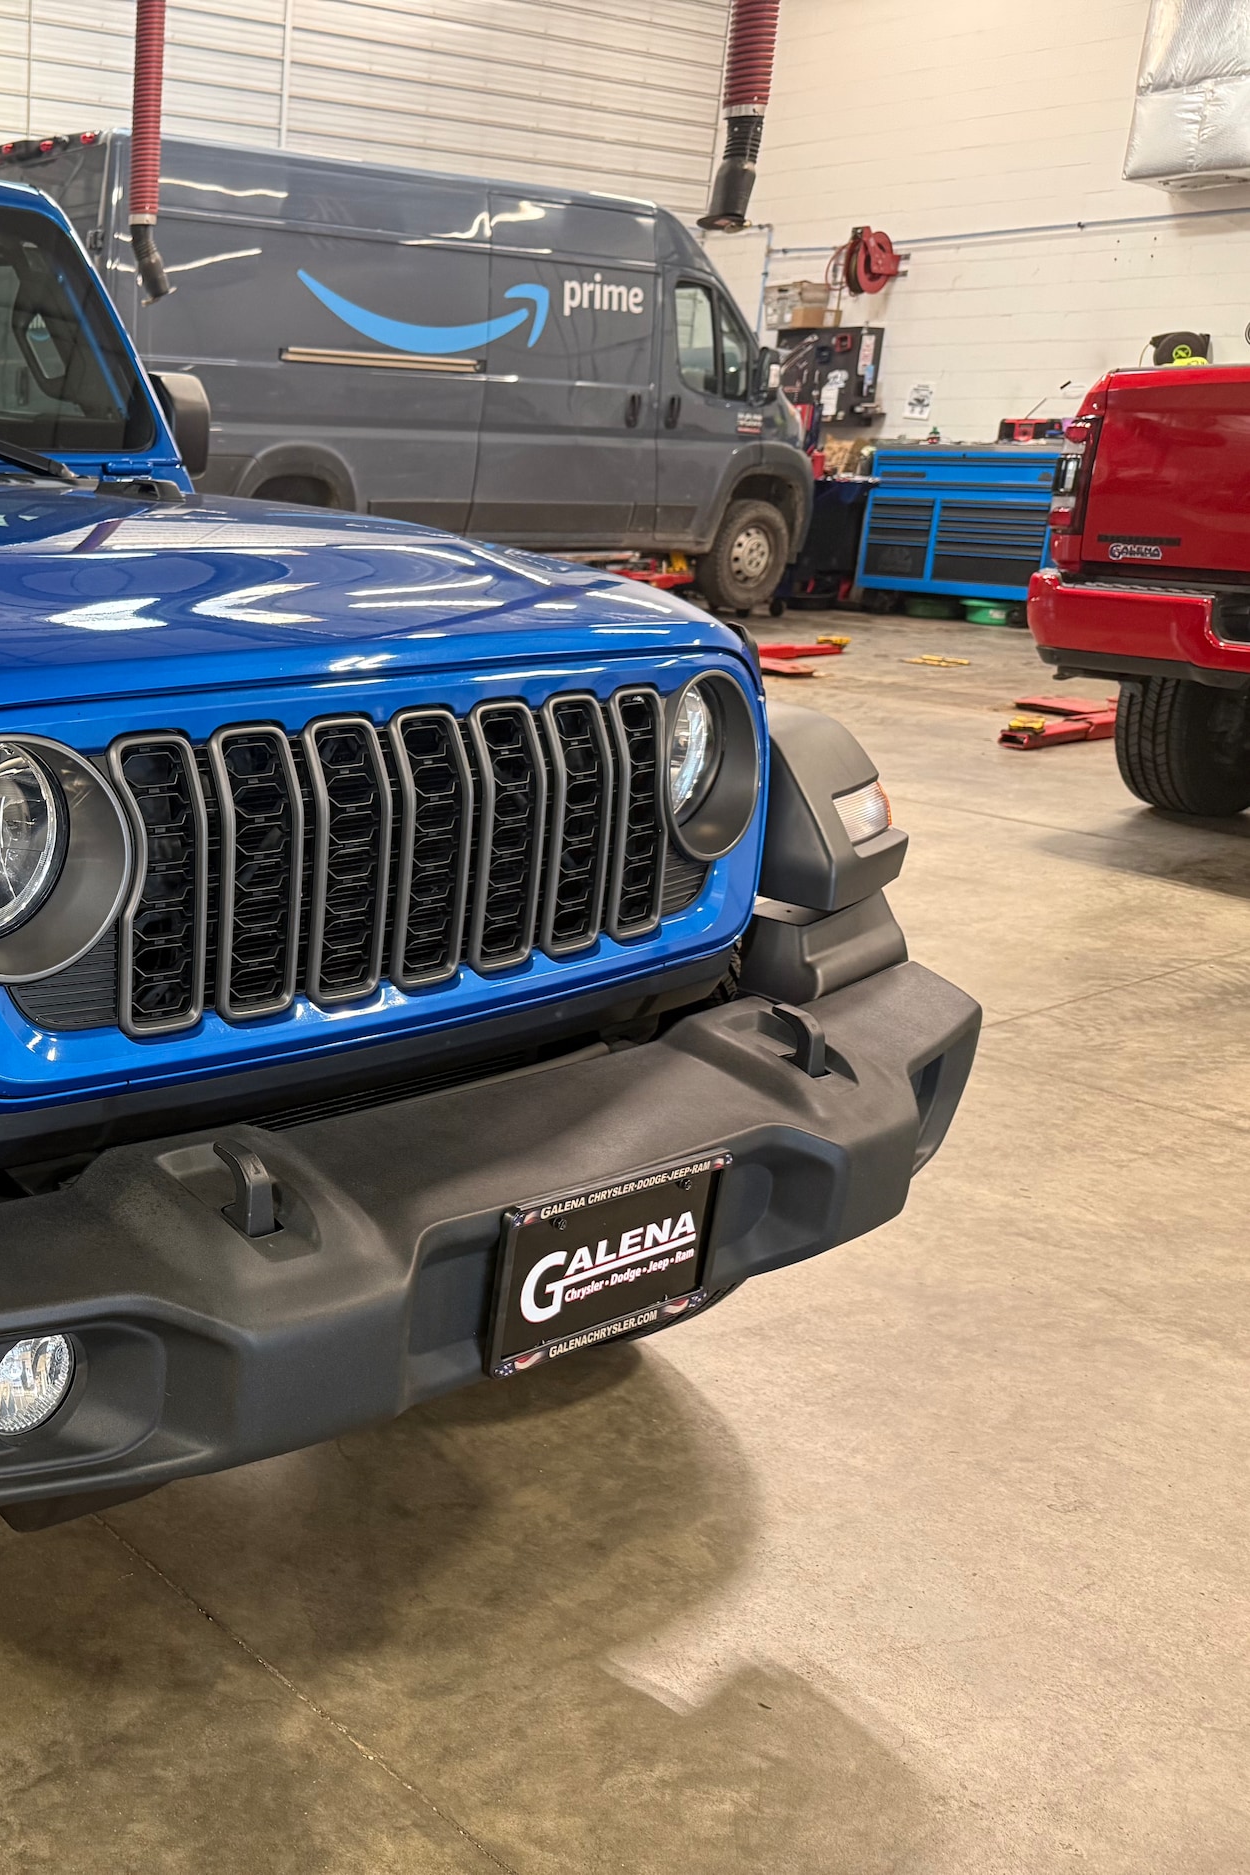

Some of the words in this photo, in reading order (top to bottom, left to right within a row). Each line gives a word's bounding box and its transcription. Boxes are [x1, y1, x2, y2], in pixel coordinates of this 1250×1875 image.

[563, 272, 644, 317] prime
[541, 1197, 585, 1219] GALENA
[520, 1211, 696, 1323] GALENA
[564, 1279, 604, 1303] Chrysler
[609, 1266, 641, 1287] Dodge
[646, 1257, 669, 1274] Jeep
[675, 1247, 695, 1264] Ram
[549, 1310, 658, 1358] GALENACHRYSLER.COM
